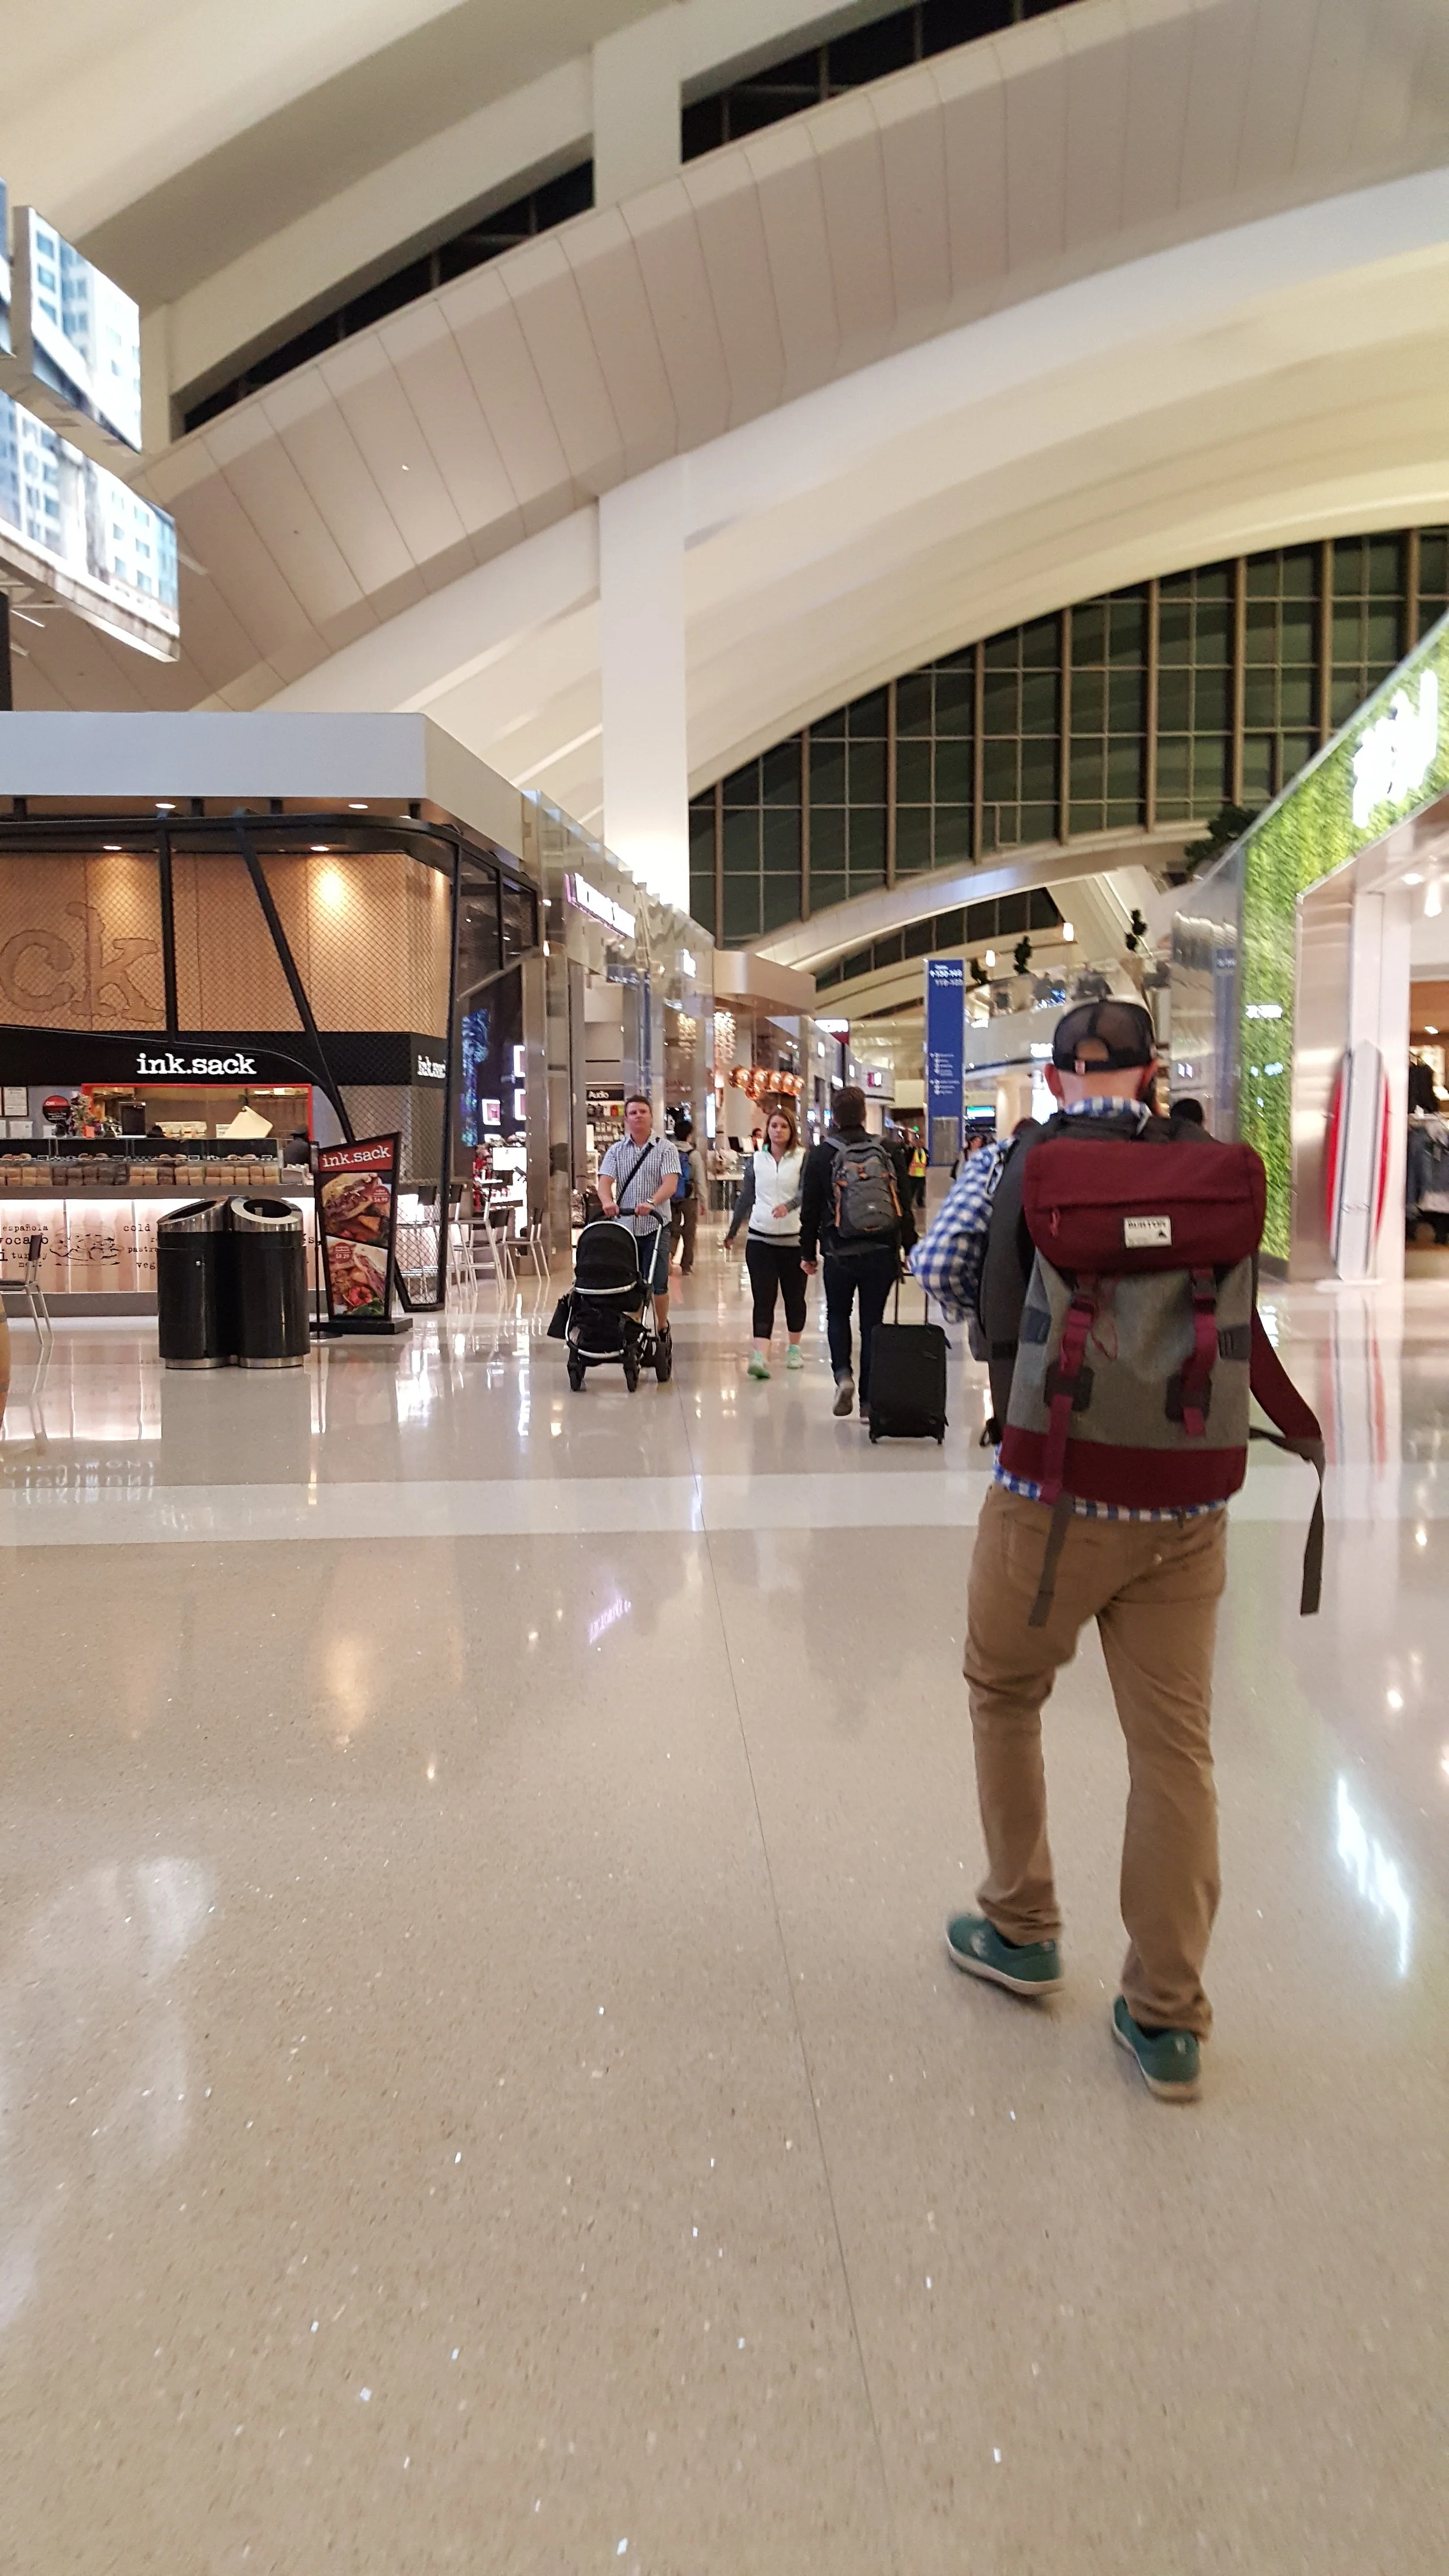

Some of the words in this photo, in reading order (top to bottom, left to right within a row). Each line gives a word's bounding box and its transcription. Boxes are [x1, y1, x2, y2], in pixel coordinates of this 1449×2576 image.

[136, 1053, 257, 1075] ink.sack
[322, 1145, 391, 1168] ink.sack
[3, 1224, 48, 1232] española
[123, 1224, 151, 1232] cold
